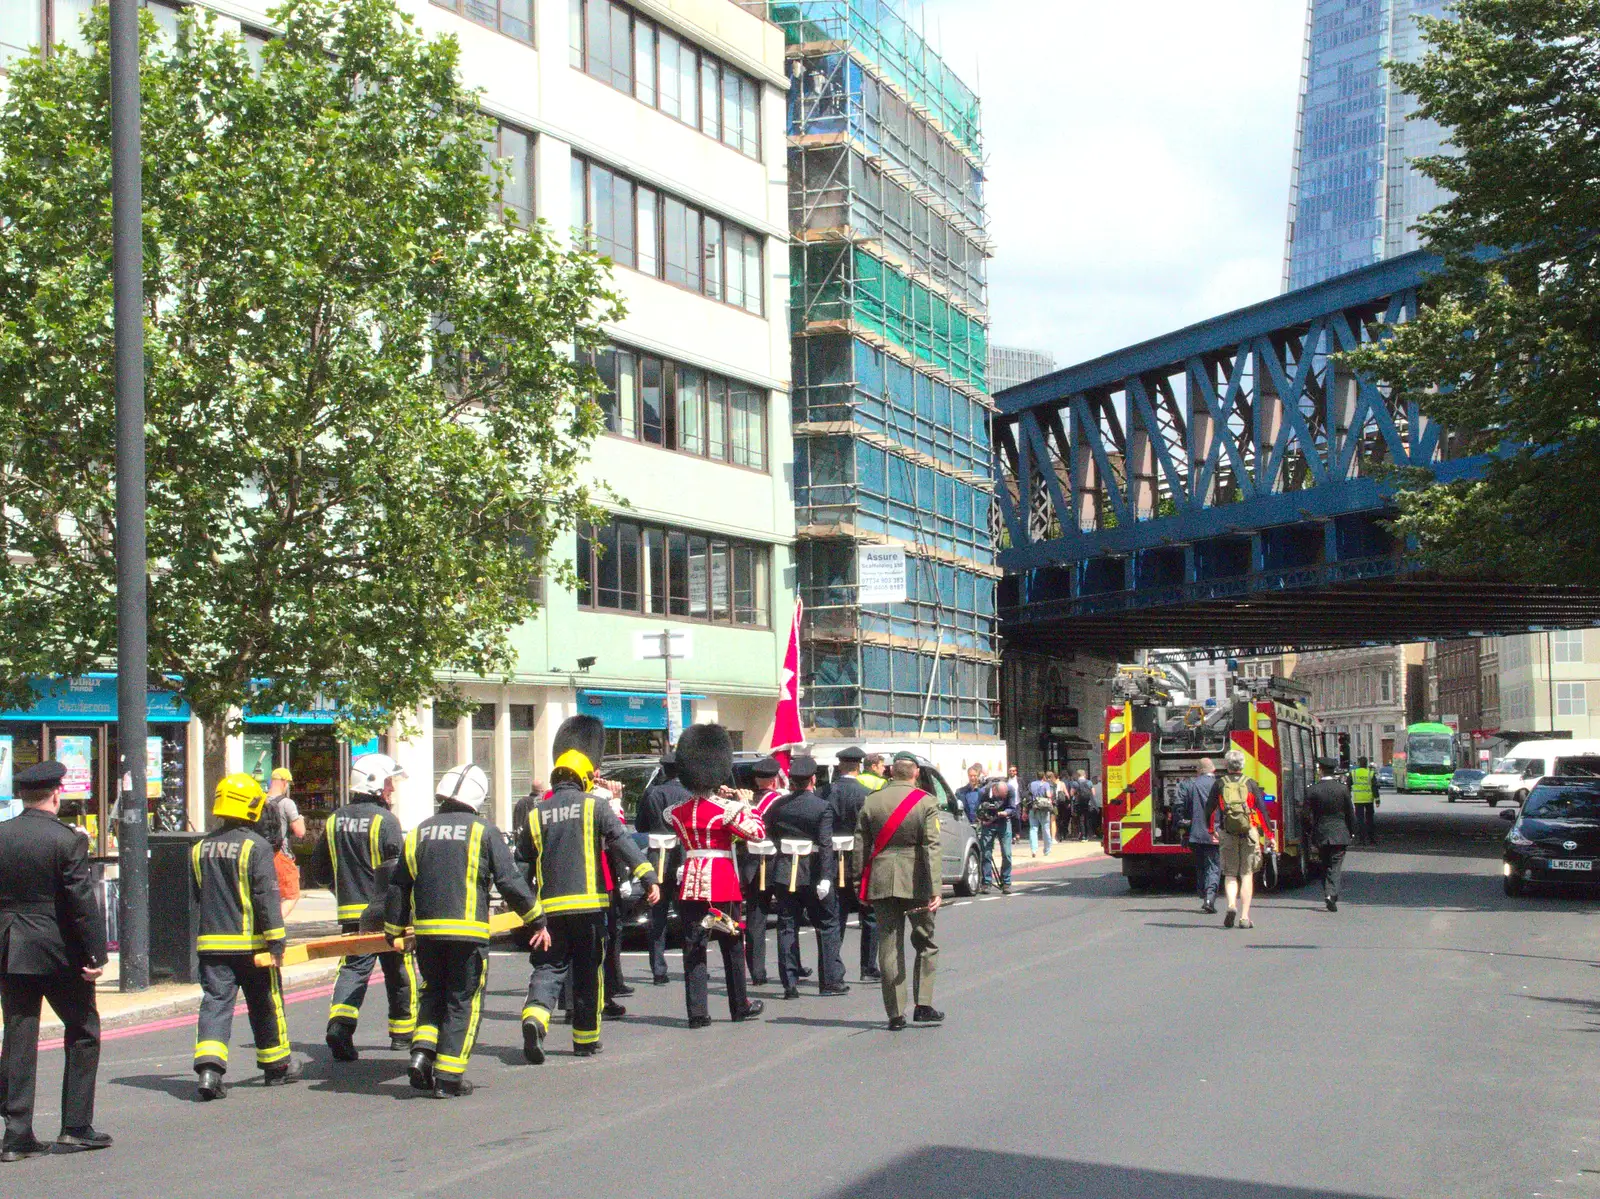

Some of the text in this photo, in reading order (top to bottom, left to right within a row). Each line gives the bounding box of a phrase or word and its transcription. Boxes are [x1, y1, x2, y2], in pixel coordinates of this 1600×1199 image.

[867, 553, 898, 561] Assure
[541, 804, 581, 825] FIRE
[336, 817, 371, 833] FIRE
[420, 825, 467, 842] FIRE
[200, 842, 240, 859] FIRE
